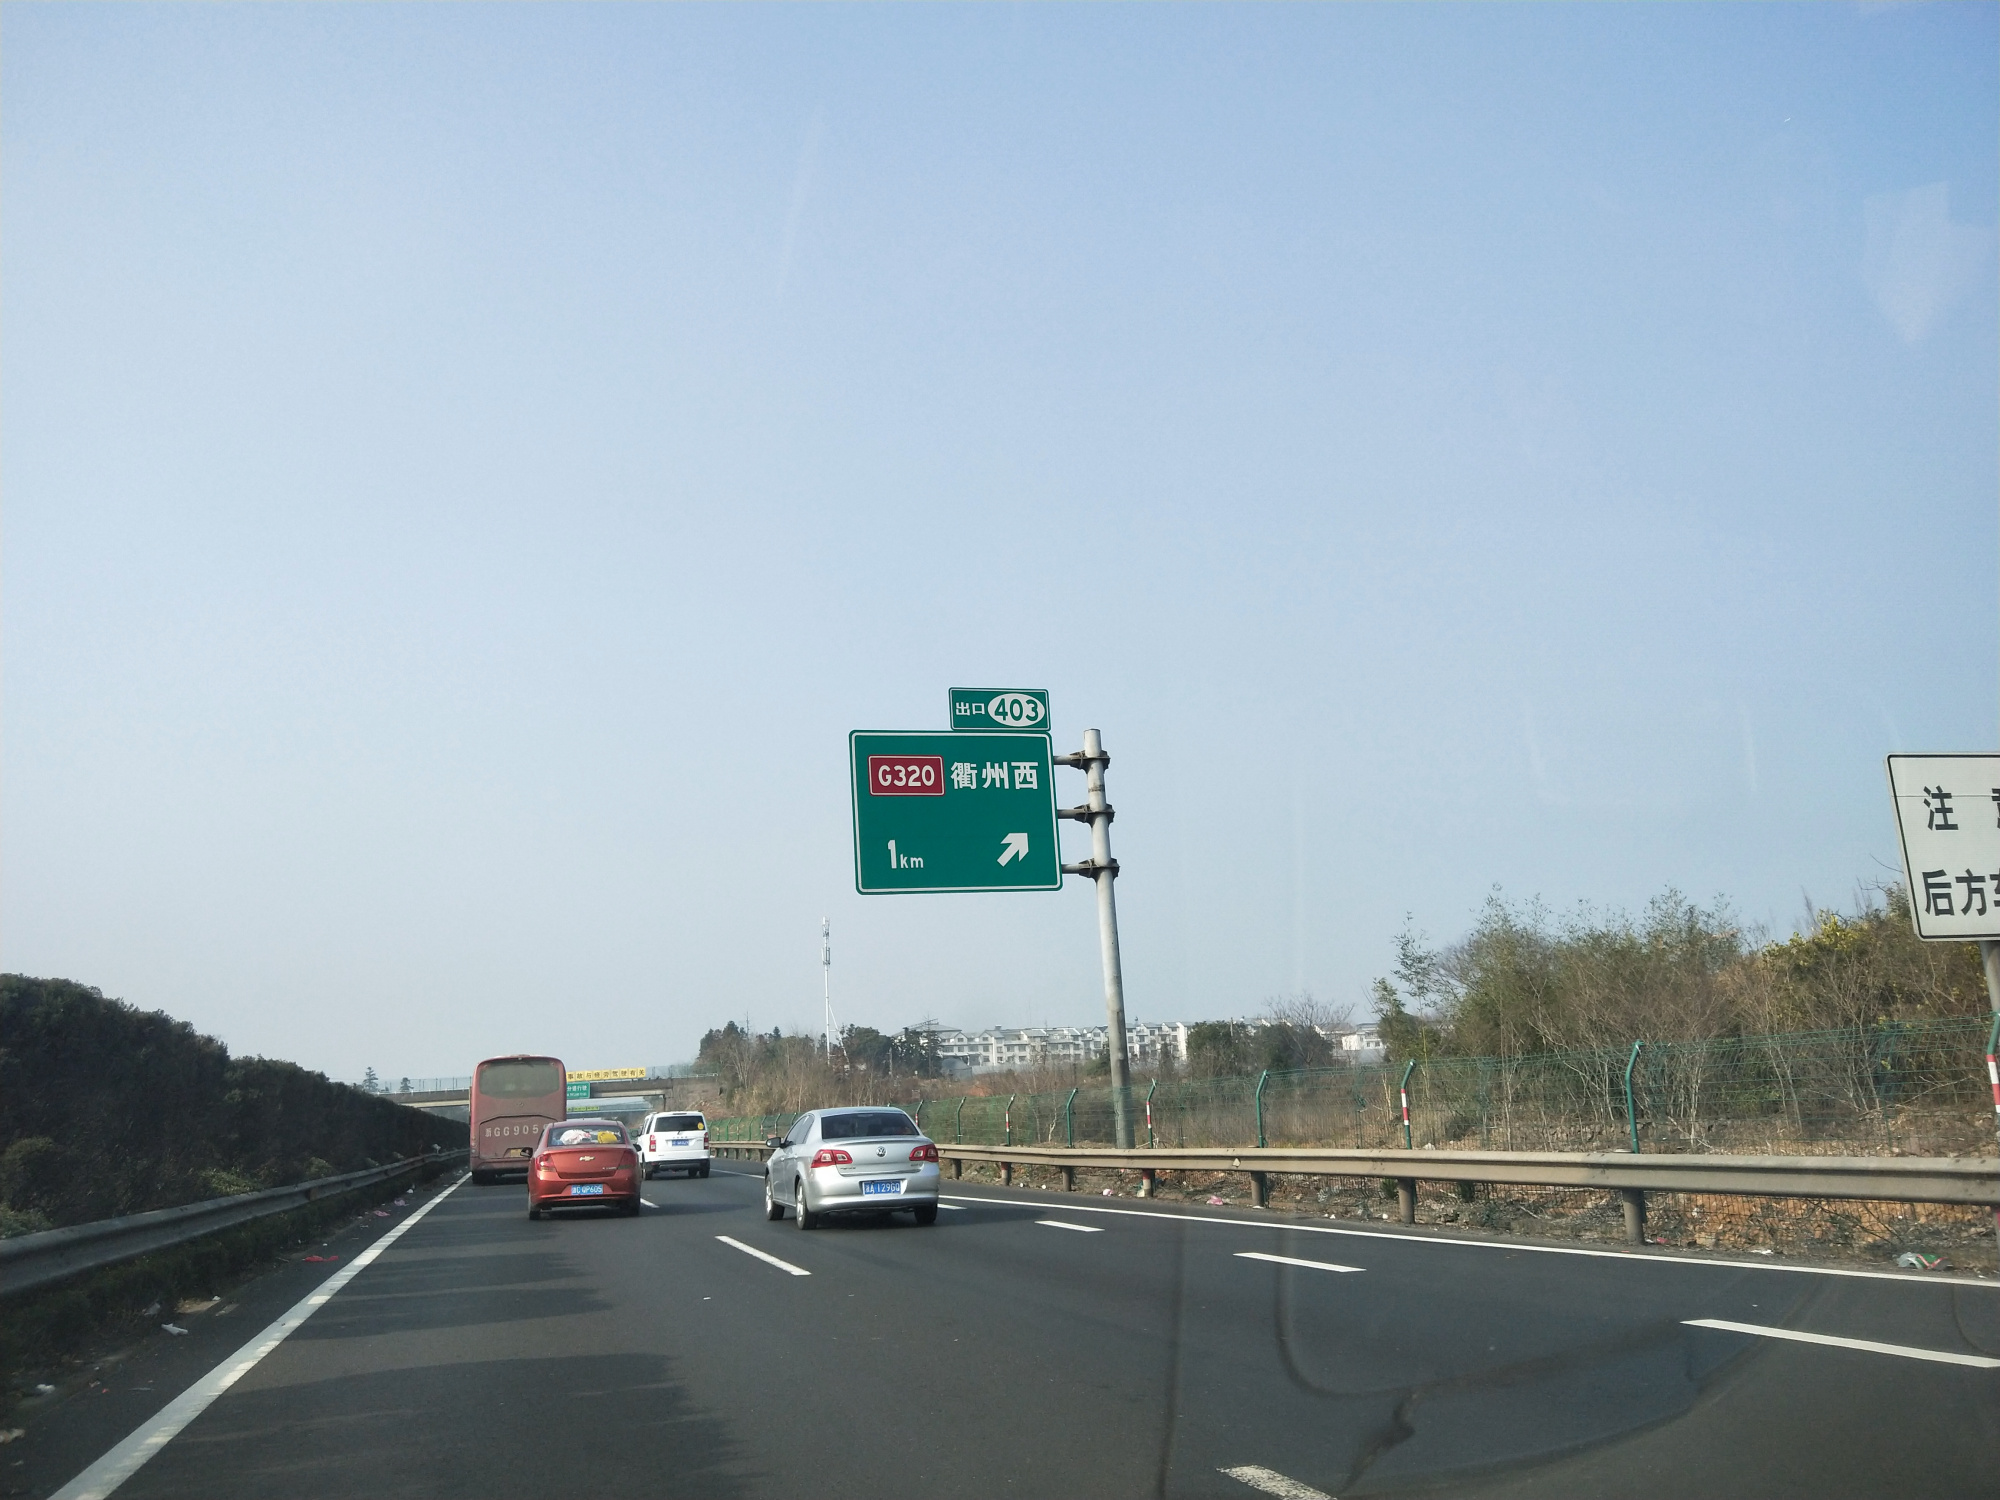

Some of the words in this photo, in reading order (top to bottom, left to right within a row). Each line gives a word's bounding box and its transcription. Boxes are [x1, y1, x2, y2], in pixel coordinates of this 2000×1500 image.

[955, 701, 985, 716] 出口
[994, 698, 1039, 721] 403
[878, 765, 935, 787] G320
[950, 761, 1039, 790] 衢州西
[485, 1124, 549, 1137] 浙GG905
